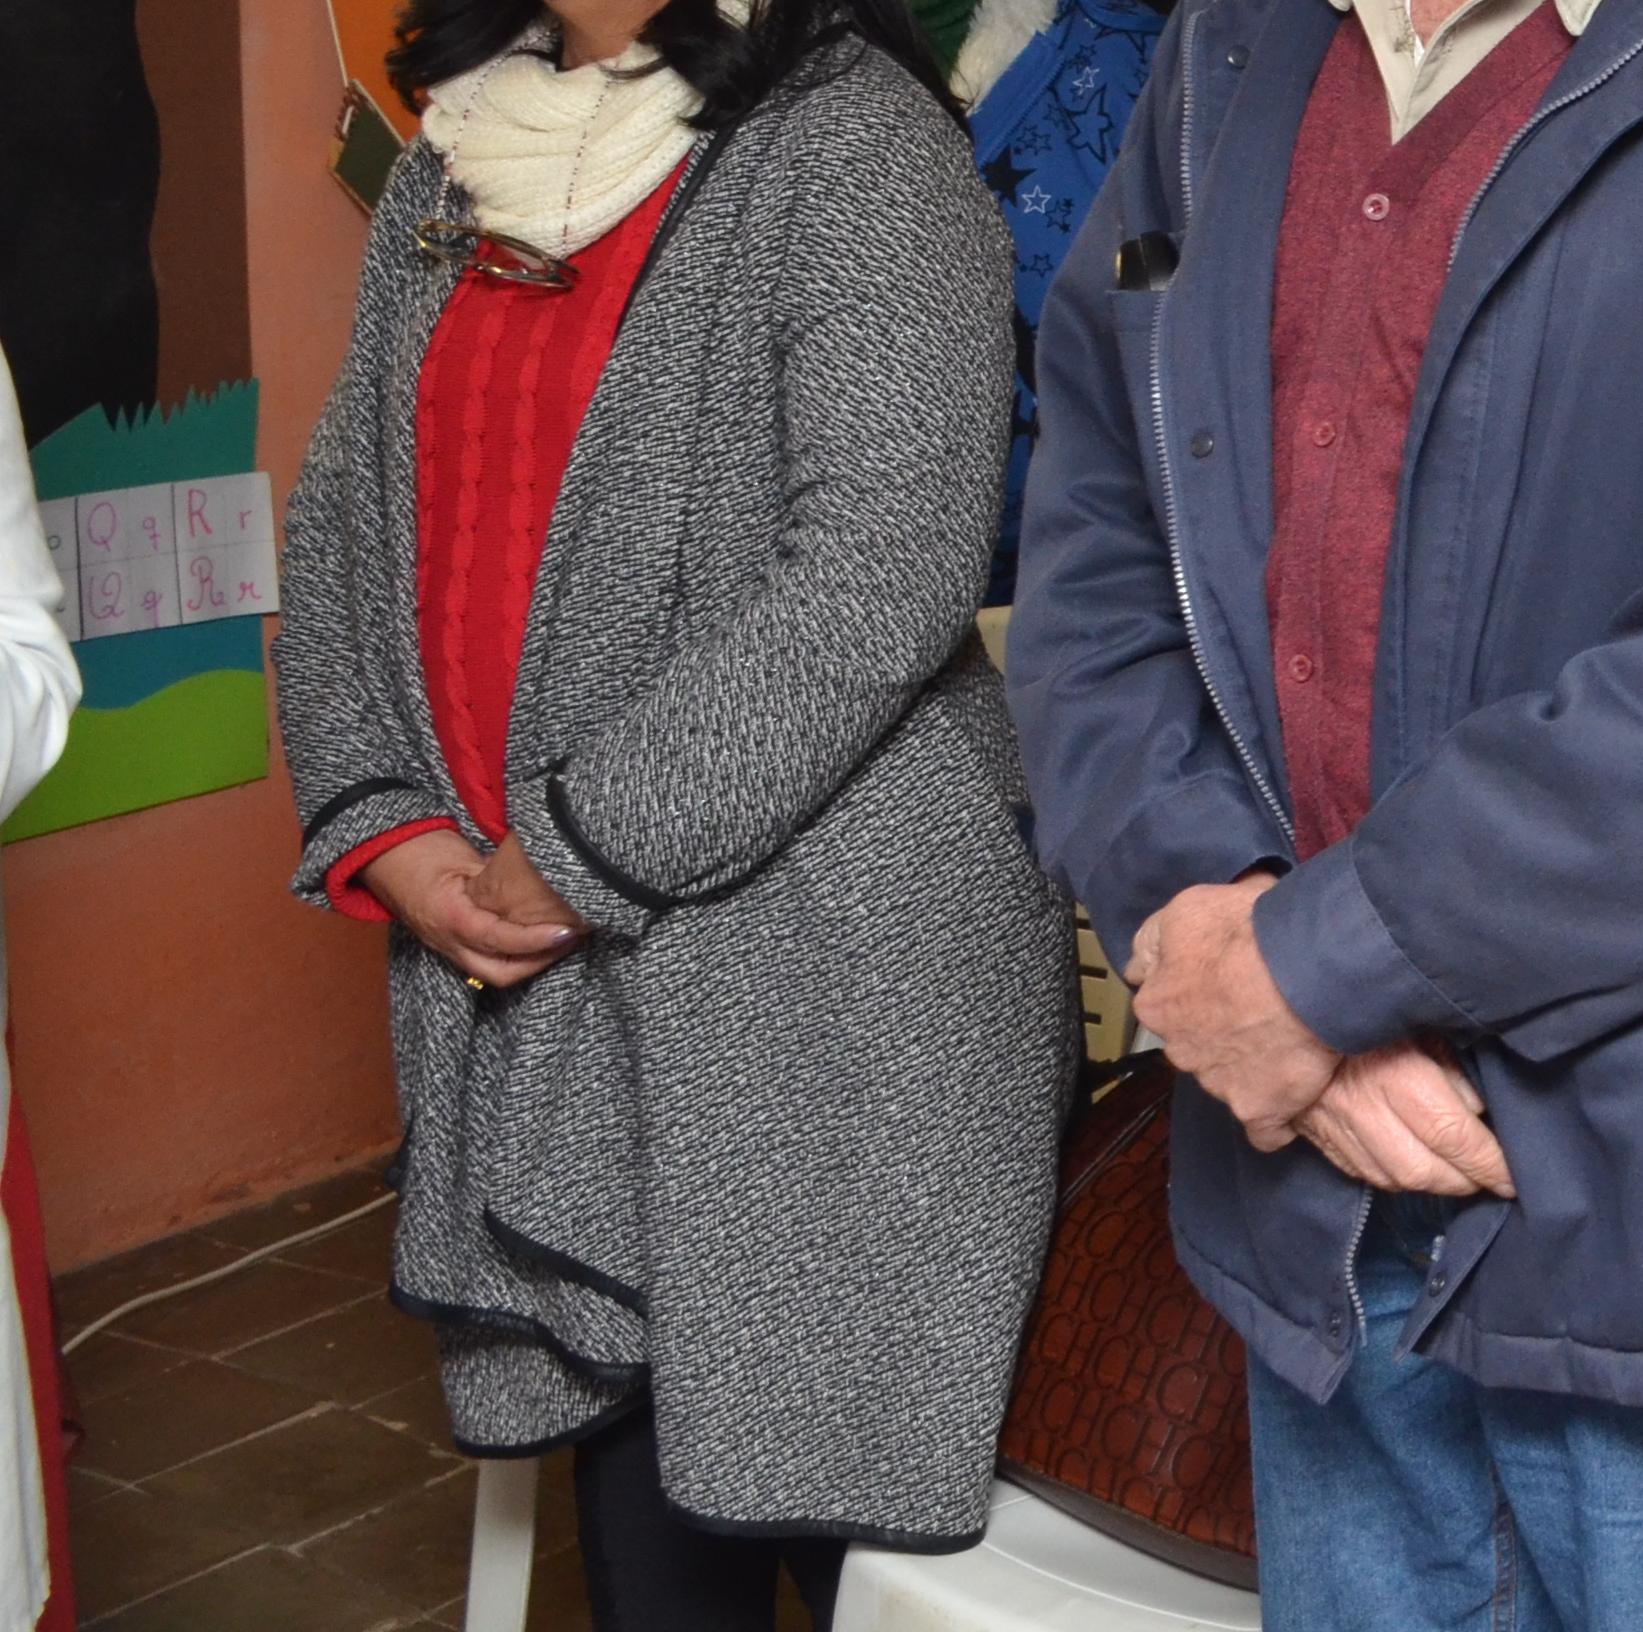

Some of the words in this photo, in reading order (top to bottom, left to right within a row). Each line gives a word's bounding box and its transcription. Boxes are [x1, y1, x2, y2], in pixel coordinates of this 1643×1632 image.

[87, 501, 118, 553] Q
[142, 516, 160, 551] q
[187, 488, 213, 538] R
[238, 509, 253, 530] r
